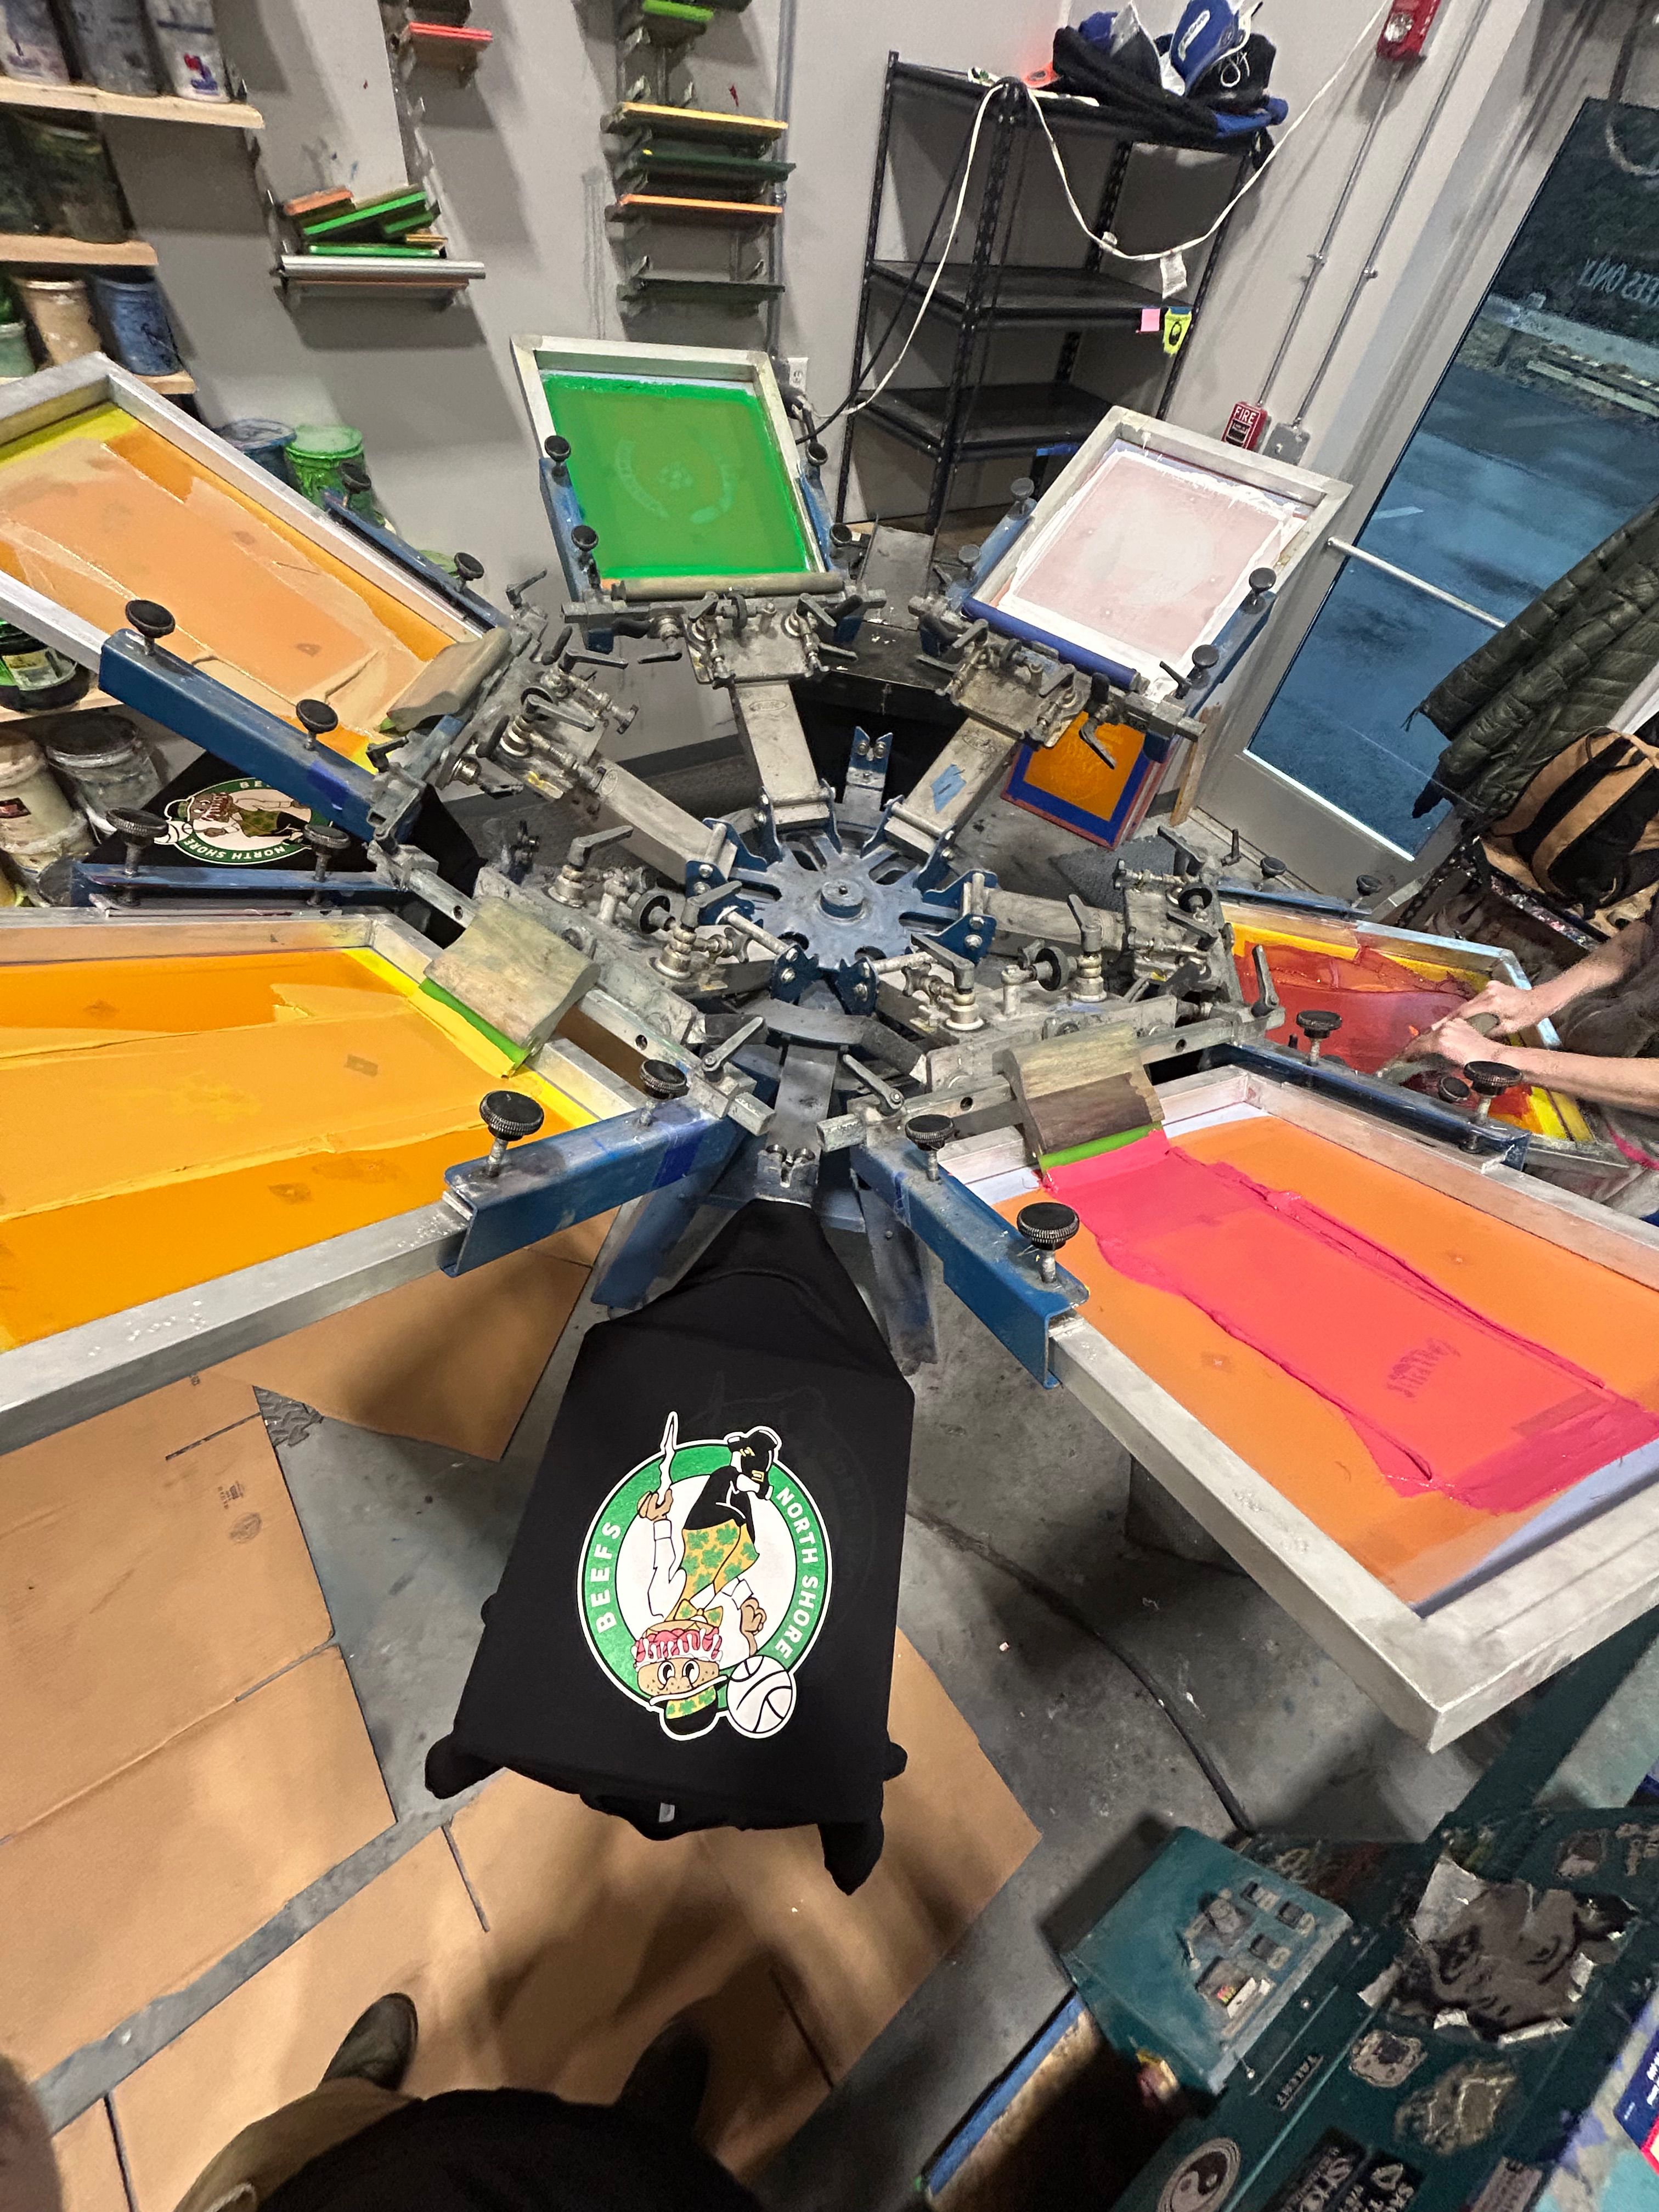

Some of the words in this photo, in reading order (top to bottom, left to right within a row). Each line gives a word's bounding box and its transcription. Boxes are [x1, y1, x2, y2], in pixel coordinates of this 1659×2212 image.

[1234, 406, 1256, 424] FIRE
[183, 838, 226, 859] SHORE
[232, 845, 286, 860] NORTH
[776, 1486, 819, 1564] NORTH
[590, 1522, 621, 1633] BEEFS
[775, 1575, 819, 1659] SHORE
